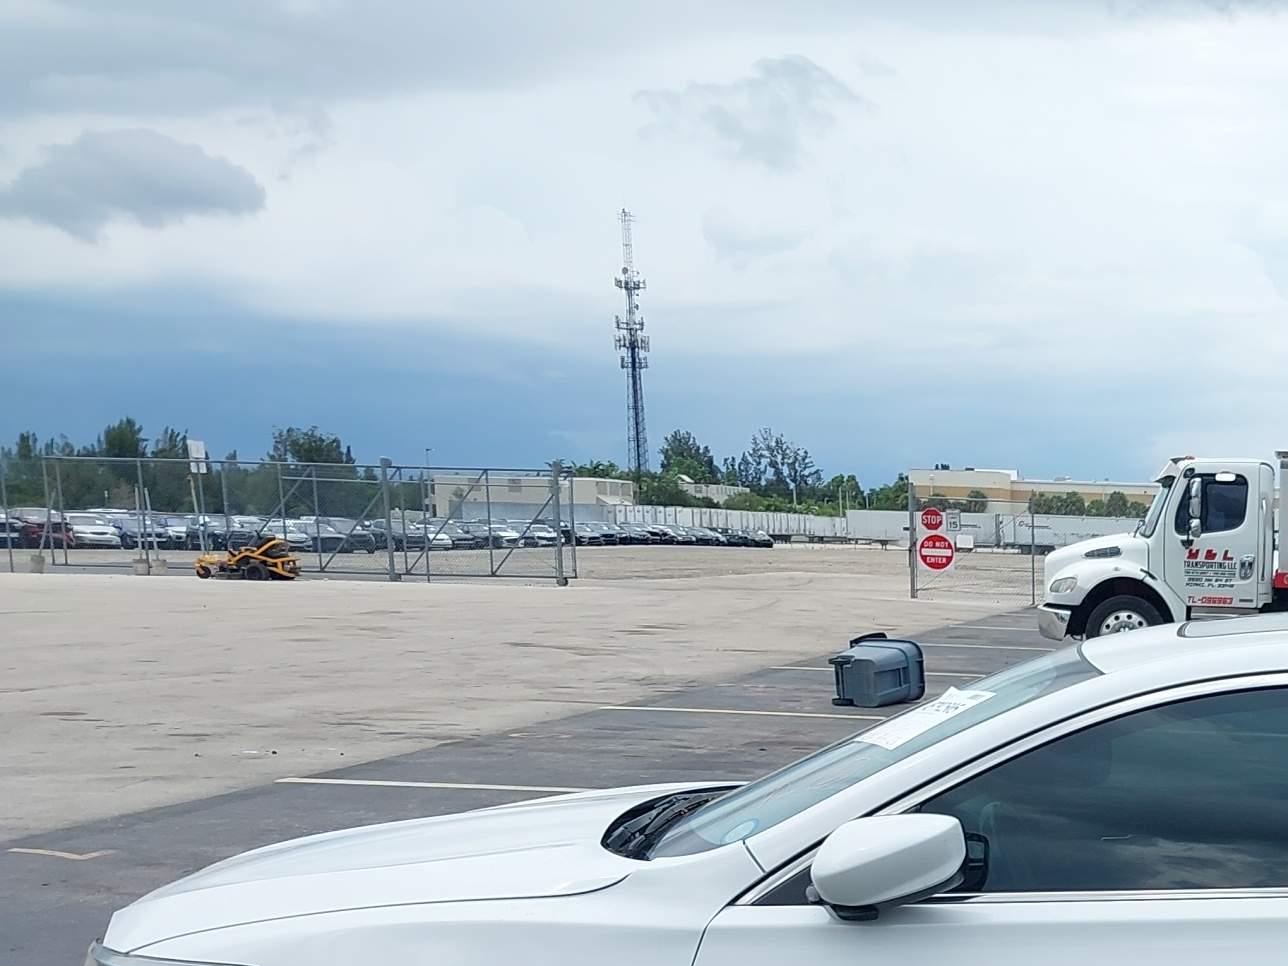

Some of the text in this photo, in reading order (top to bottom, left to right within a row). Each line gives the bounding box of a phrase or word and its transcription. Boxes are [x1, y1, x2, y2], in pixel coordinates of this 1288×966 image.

[922, 515, 942, 524] STOP
[949, 521, 958, 529] 15
[1222, 549, 1234, 561] L
[1184, 561, 1226, 569] TRANSPORTING
